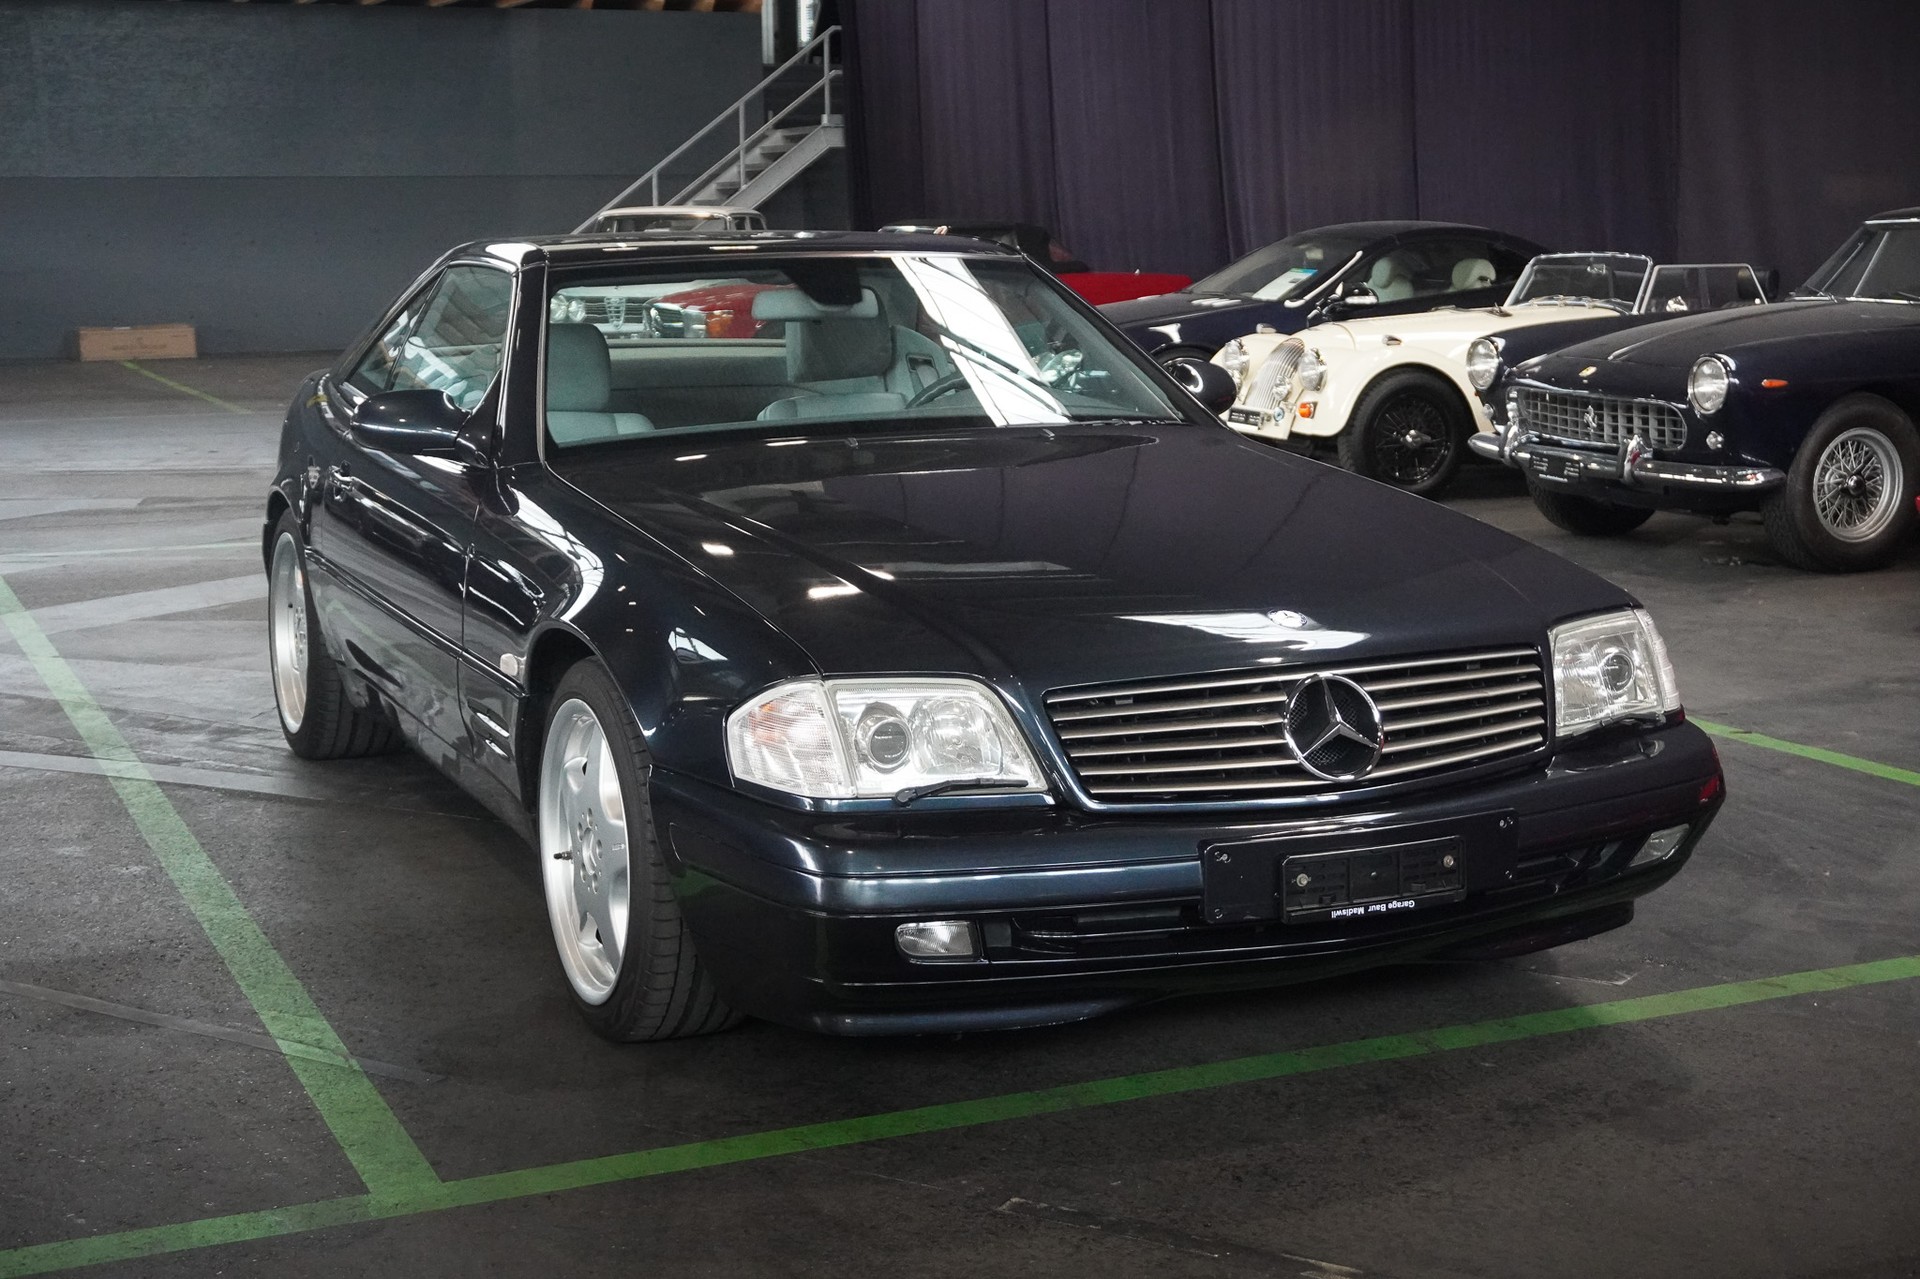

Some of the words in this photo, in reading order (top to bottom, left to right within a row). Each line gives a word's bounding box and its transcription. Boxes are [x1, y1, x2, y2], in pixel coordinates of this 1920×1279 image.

[1367, 903, 1387, 912] Baur
[1387, 900, 1415, 909] Garage
[1331, 907, 1365, 918] Madiswil
